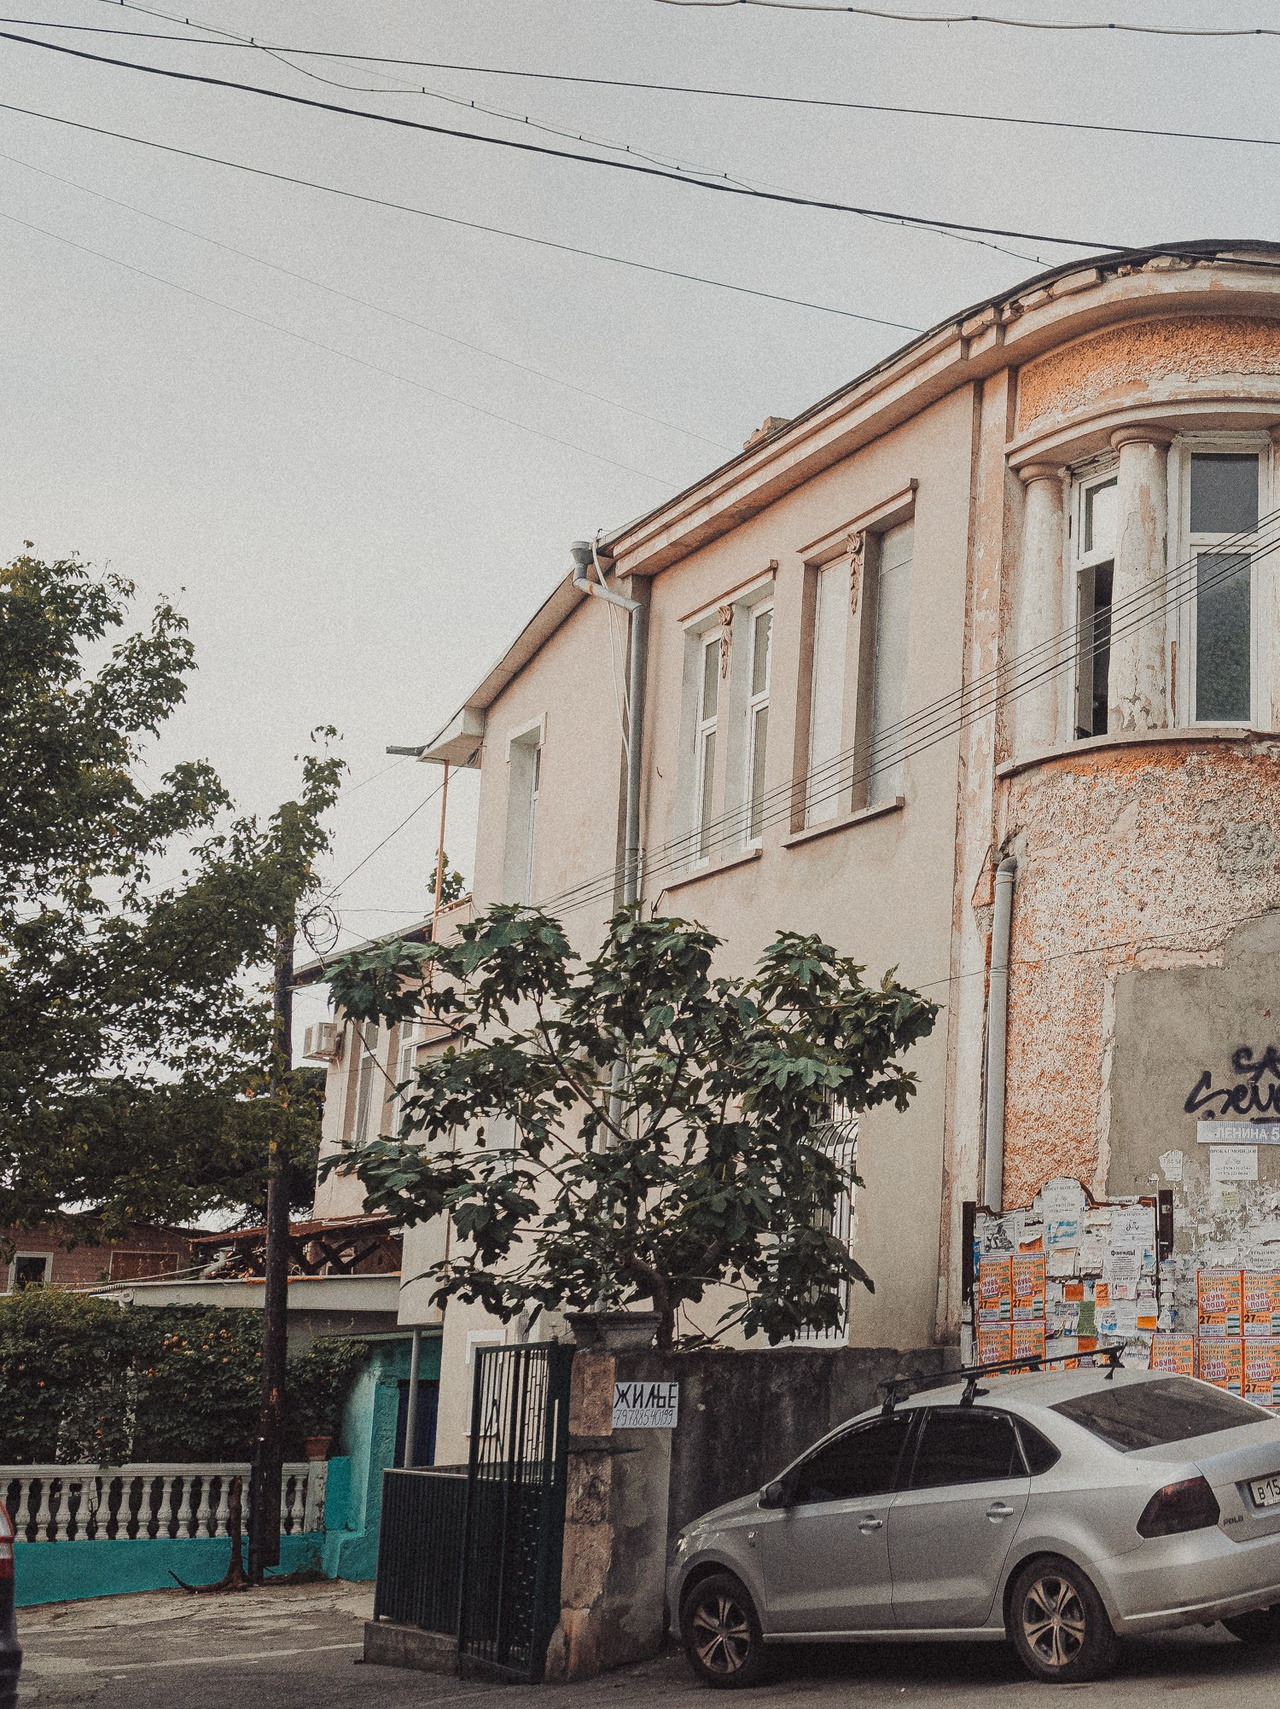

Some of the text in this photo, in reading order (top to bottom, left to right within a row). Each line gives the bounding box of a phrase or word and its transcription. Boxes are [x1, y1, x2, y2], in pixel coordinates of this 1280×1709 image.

[1215, 1127, 1280, 1141] ЛЕНИНА 5
[1200, 1294, 1226, 1303] ОБУВЬ
[1245, 1292, 1270, 1301] ОБУВЬ
[979, 1300, 988, 1309] 27
[1013, 1299, 1021, 1308] 27
[1199, 1315, 1211, 1325] 27
[1244, 1314, 1256, 1323] 27
[1154, 1358, 1177, 1367] ОБУВЬ
[1201, 1362, 1226, 1371] ОБУВЬ
[1246, 1362, 1272, 1371] ОБУВЬ
[1245, 1383, 1257, 1393] 27
[1222, 1514, 1244, 1526] POLO
